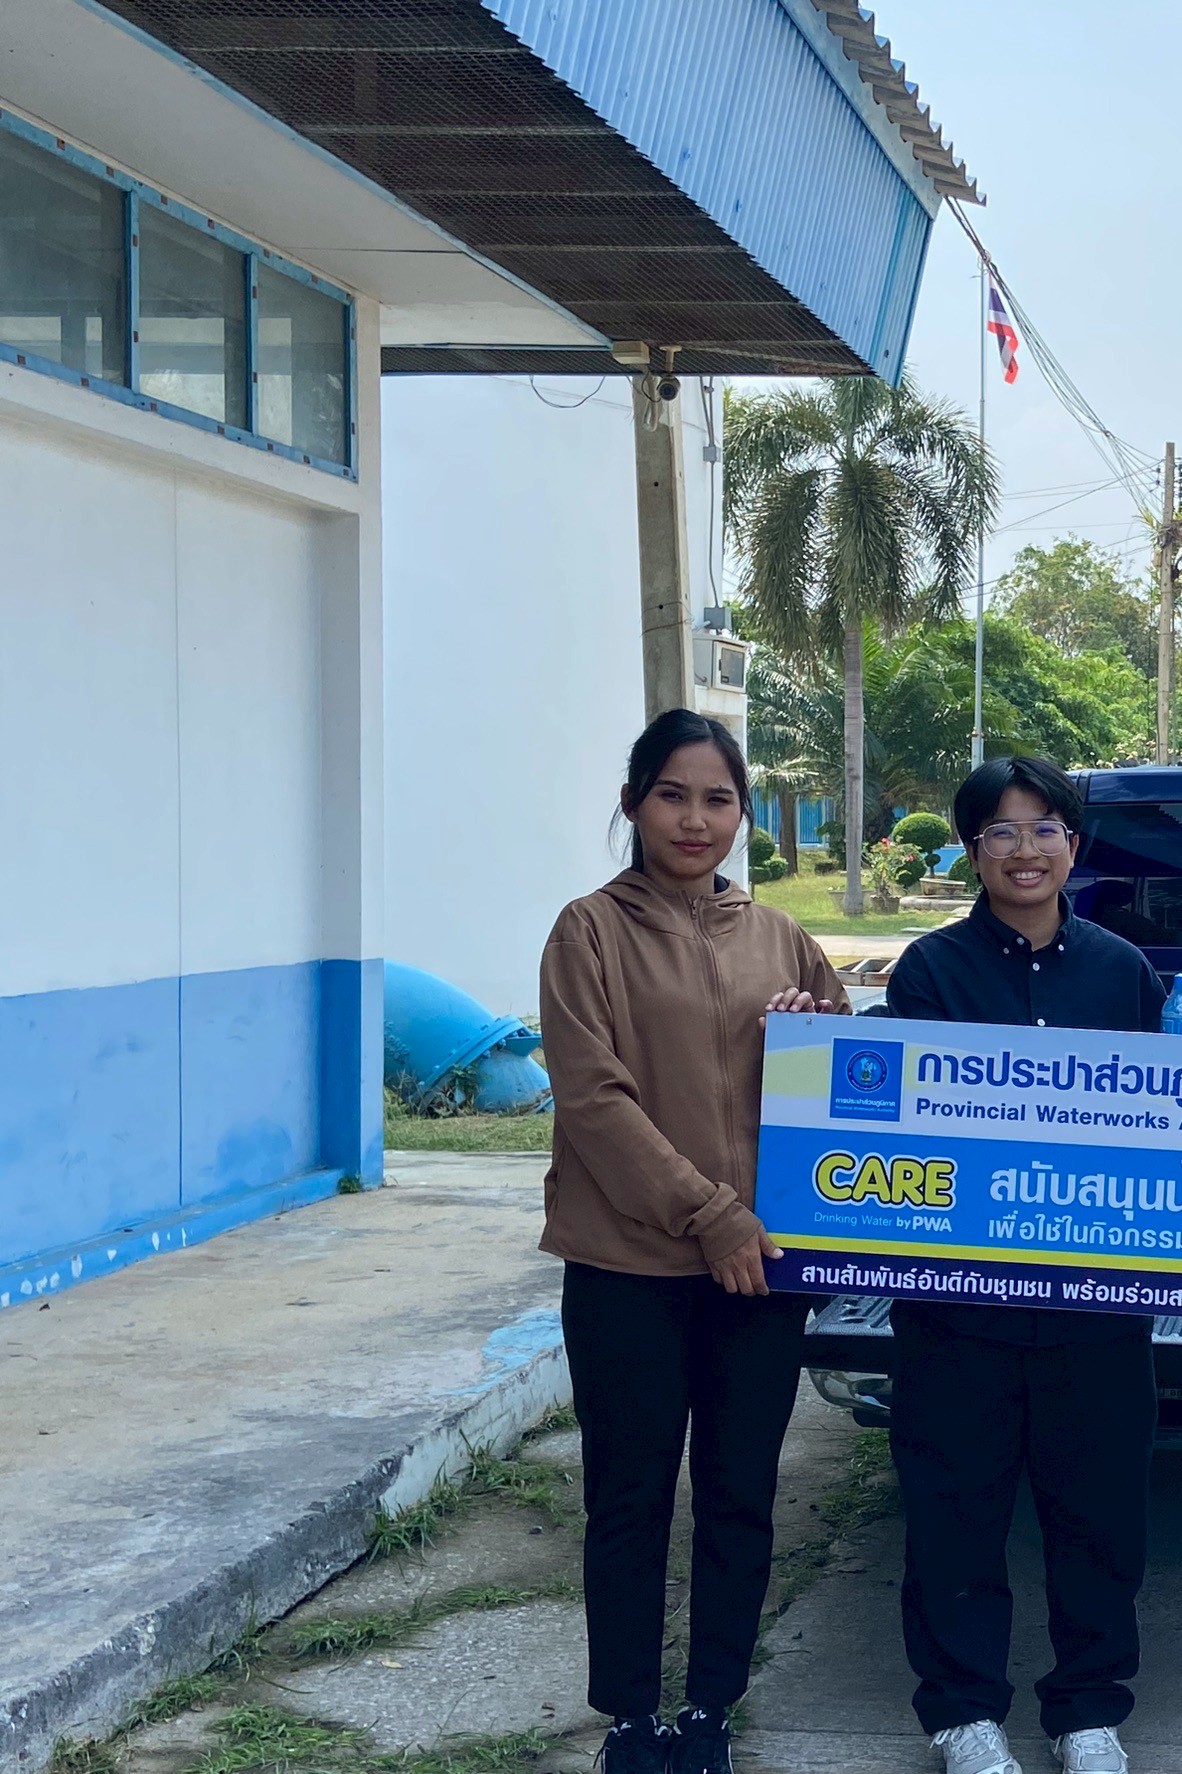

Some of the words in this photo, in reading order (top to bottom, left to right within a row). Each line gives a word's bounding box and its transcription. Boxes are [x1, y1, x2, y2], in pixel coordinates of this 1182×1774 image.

[916, 1098, 1026, 1121] Provincial
[1036, 1105, 1169, 1129] Waterworks
[814, 1152, 956, 1209] CARE
[814, 1212, 858, 1226] Drinking
[862, 1215, 892, 1226] Water
[896, 1216, 911, 1230] by
[912, 1215, 953, 1233] PWA
[801, 1264, 1051, 1301] สานสัมพันธ์อันดีกับชุมชน
